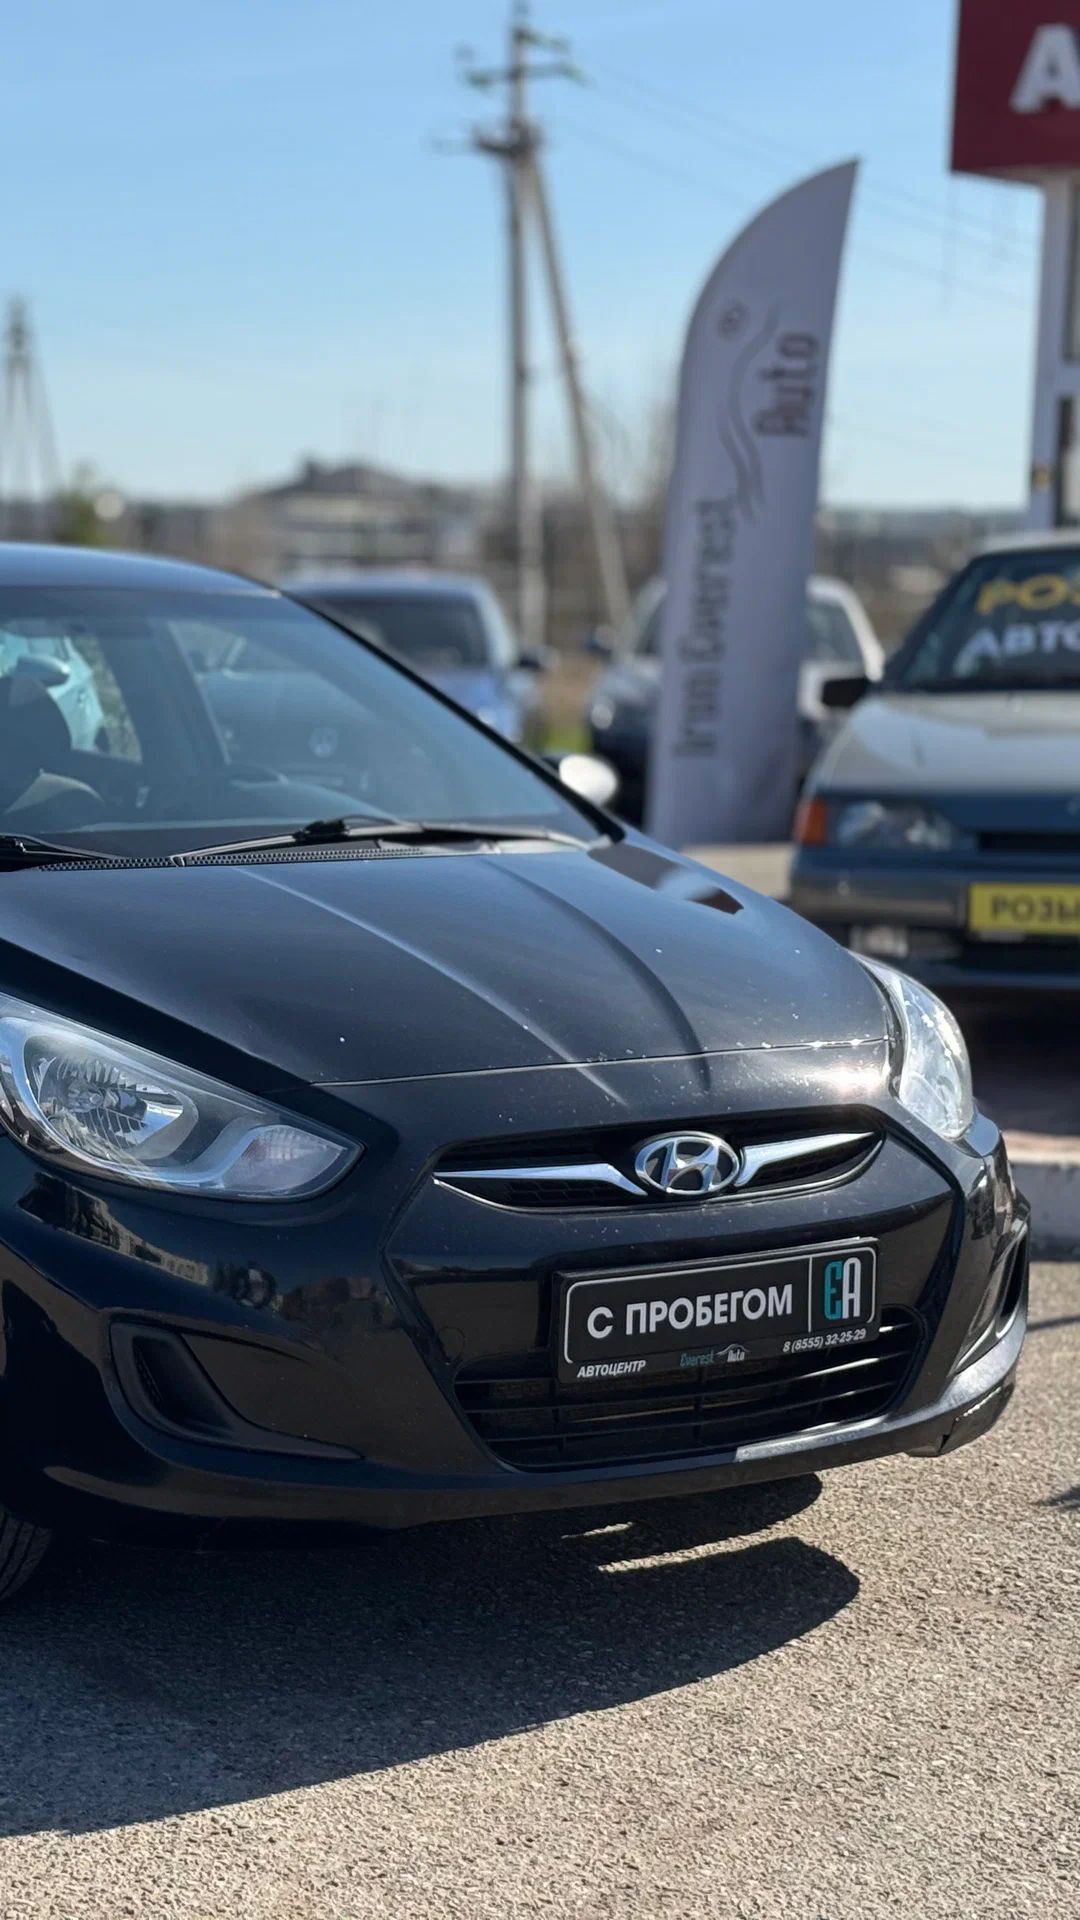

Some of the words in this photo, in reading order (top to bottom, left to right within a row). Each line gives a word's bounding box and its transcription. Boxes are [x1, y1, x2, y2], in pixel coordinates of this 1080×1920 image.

[752, 332, 819, 438] Auto
[677, 497, 736, 664] Everest
[587, 1306, 613, 1339] С
[625, 1283, 793, 1336] ПРОБЕГОМ
[680, 1352, 716, 1368] Everest
[726, 1350, 746, 1363] Auto
[783, 1341, 791, 1353] 8
[791, 1336, 824, 1353] (8555)
[825, 1328, 867, 1345] 32-25-29
[577, 1359, 647, 1378] АВТОЦЕНТР
